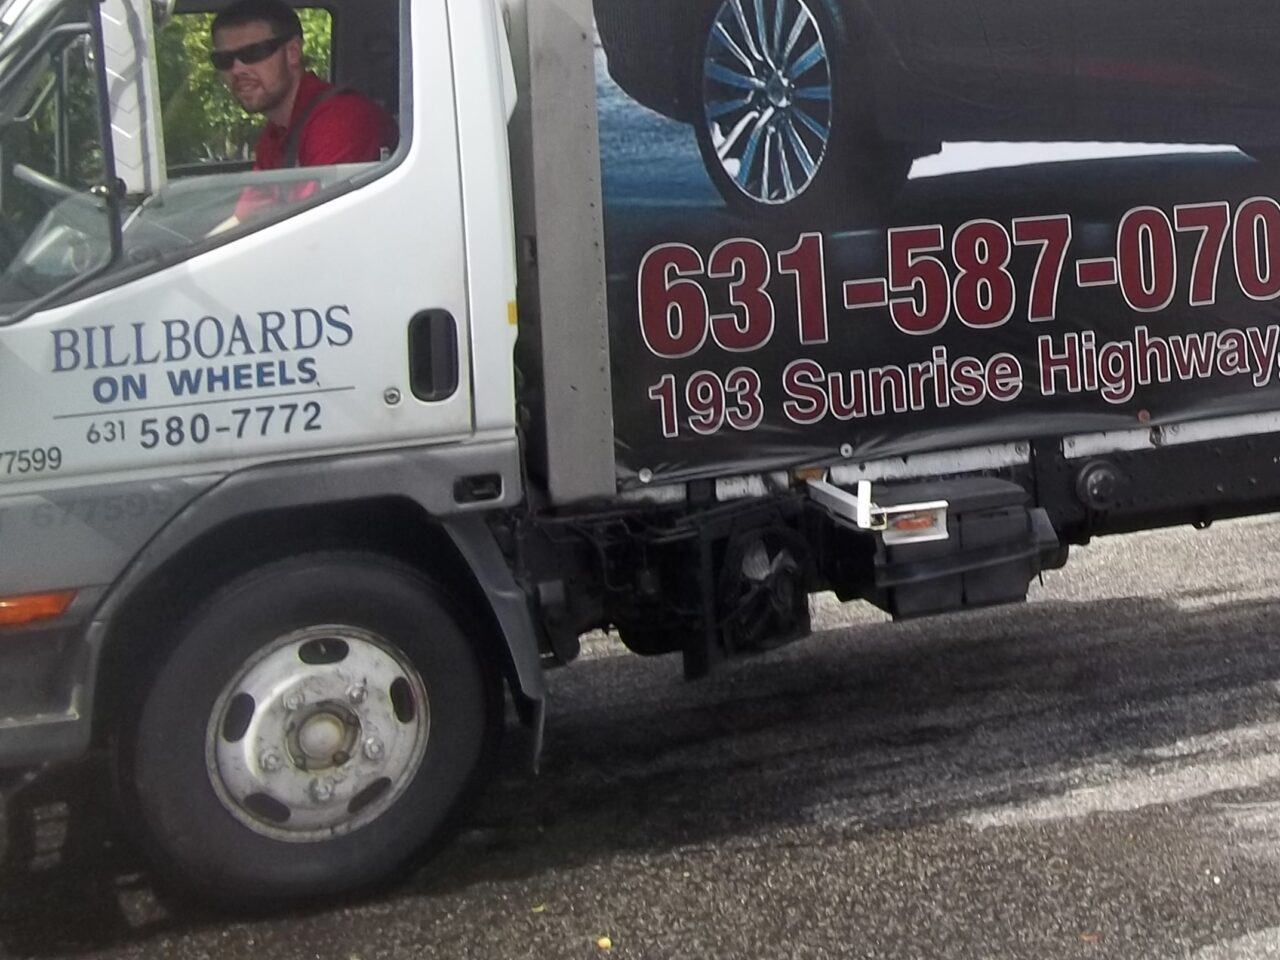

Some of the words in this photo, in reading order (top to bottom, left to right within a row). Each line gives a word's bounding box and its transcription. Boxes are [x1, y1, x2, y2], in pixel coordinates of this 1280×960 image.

[50, 304, 354, 373] BILLBOARDS
[93, 372, 148, 404] ON
[166, 357, 318, 396] WHEELS
[648, 367, 765, 438] 193
[783, 345, 1022, 424] Sunrise
[86, 420, 126, 444] 631
[140, 401, 322, 449] 580-7772
[0, 446, 62, 474] 7599
